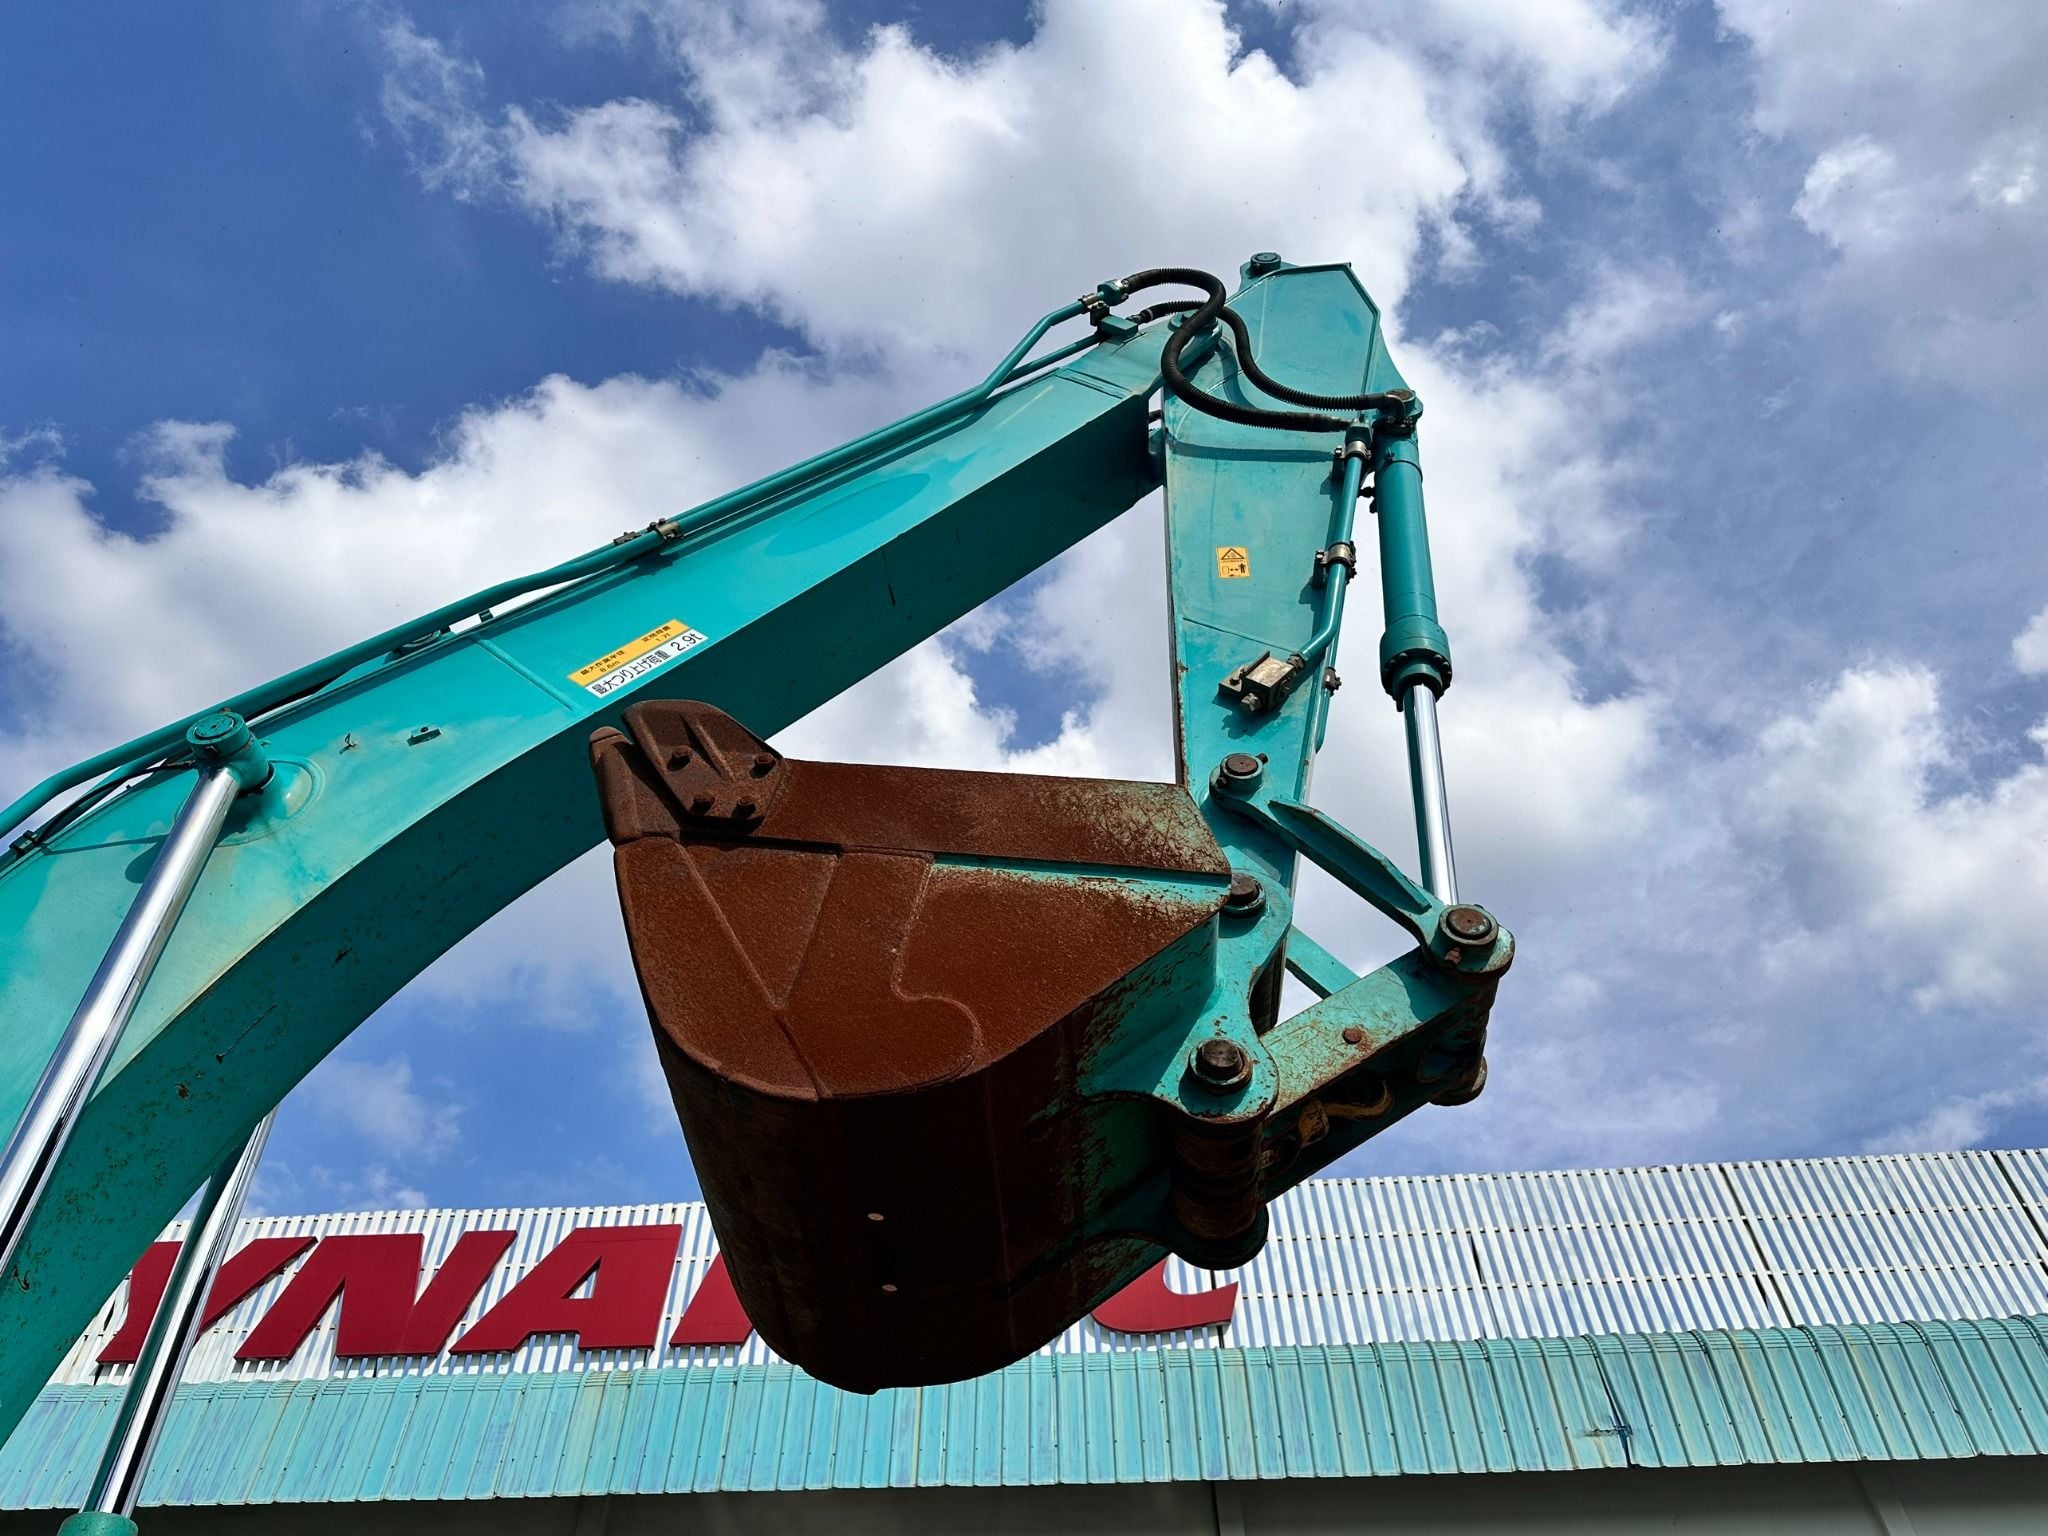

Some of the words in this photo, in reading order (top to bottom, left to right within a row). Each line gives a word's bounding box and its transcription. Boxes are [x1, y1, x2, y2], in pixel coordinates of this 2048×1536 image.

[591, 650, 671, 695] 最大つり上げ荷重
[670, 633, 703, 651] 2.9t
